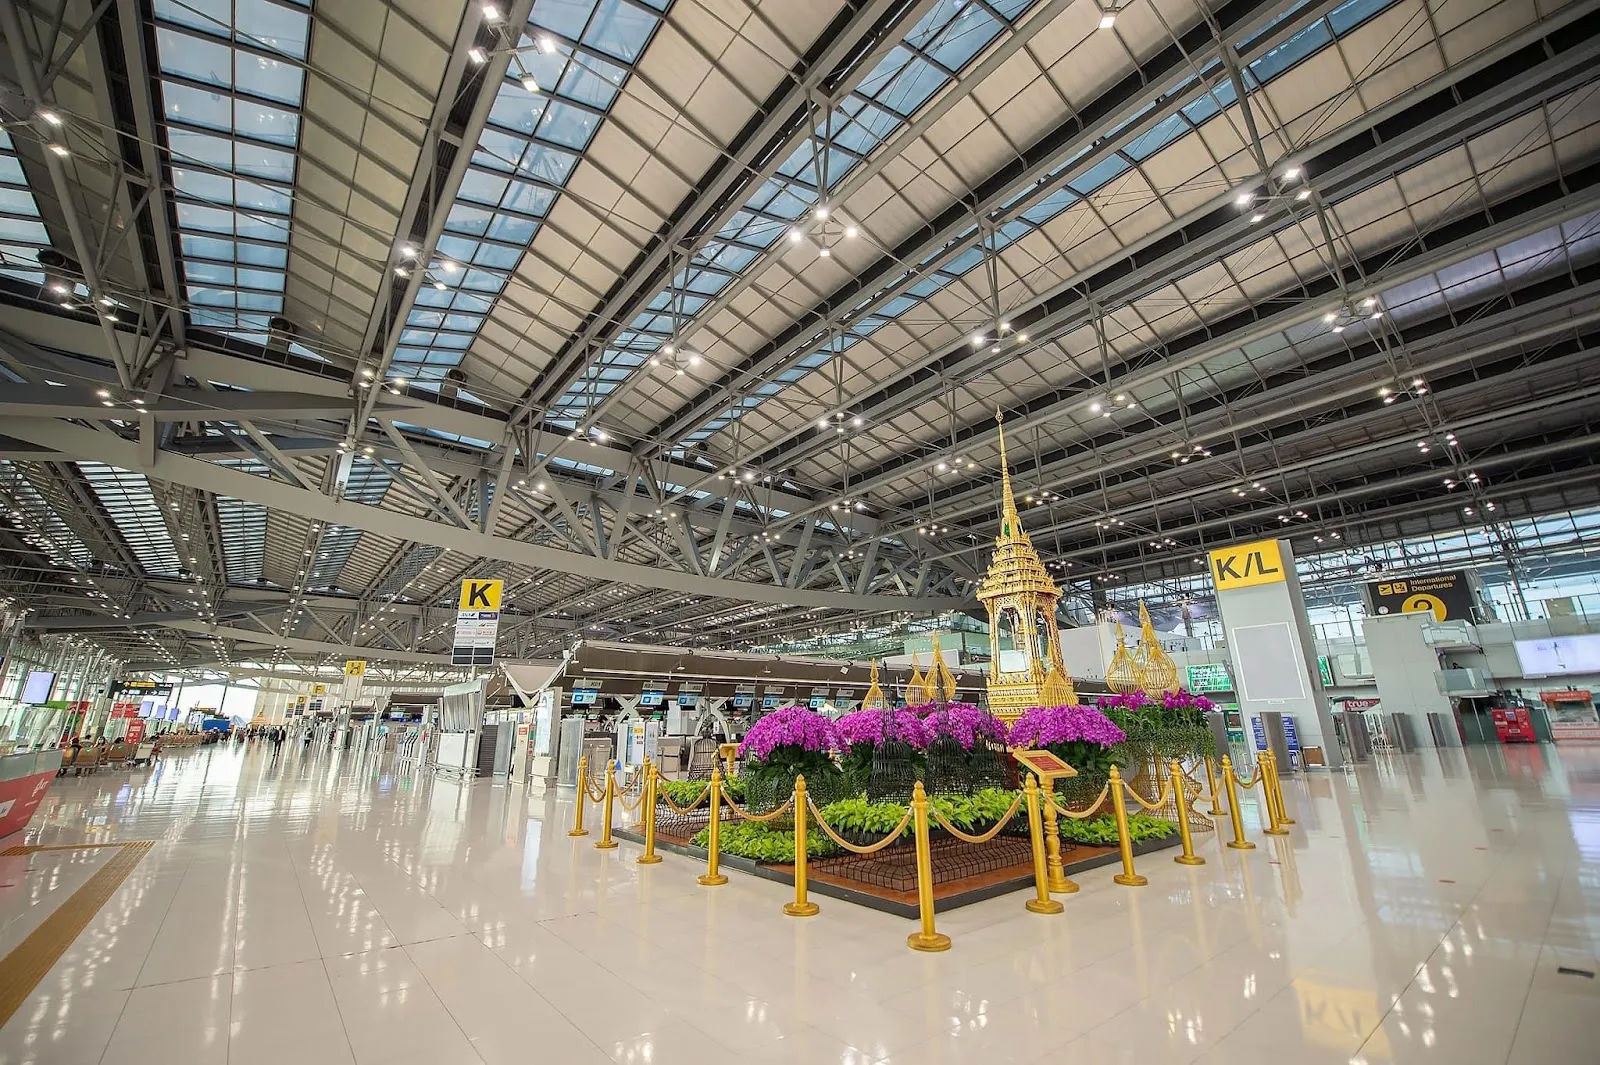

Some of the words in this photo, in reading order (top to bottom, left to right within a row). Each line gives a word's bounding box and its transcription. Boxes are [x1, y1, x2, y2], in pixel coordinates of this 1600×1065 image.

[1215, 551, 1279, 581] K/L
[1410, 574, 1457, 586] International
[1411, 582, 1454, 592] Departures
[468, 582, 493, 607] K
[315, 685, 323, 694] F
